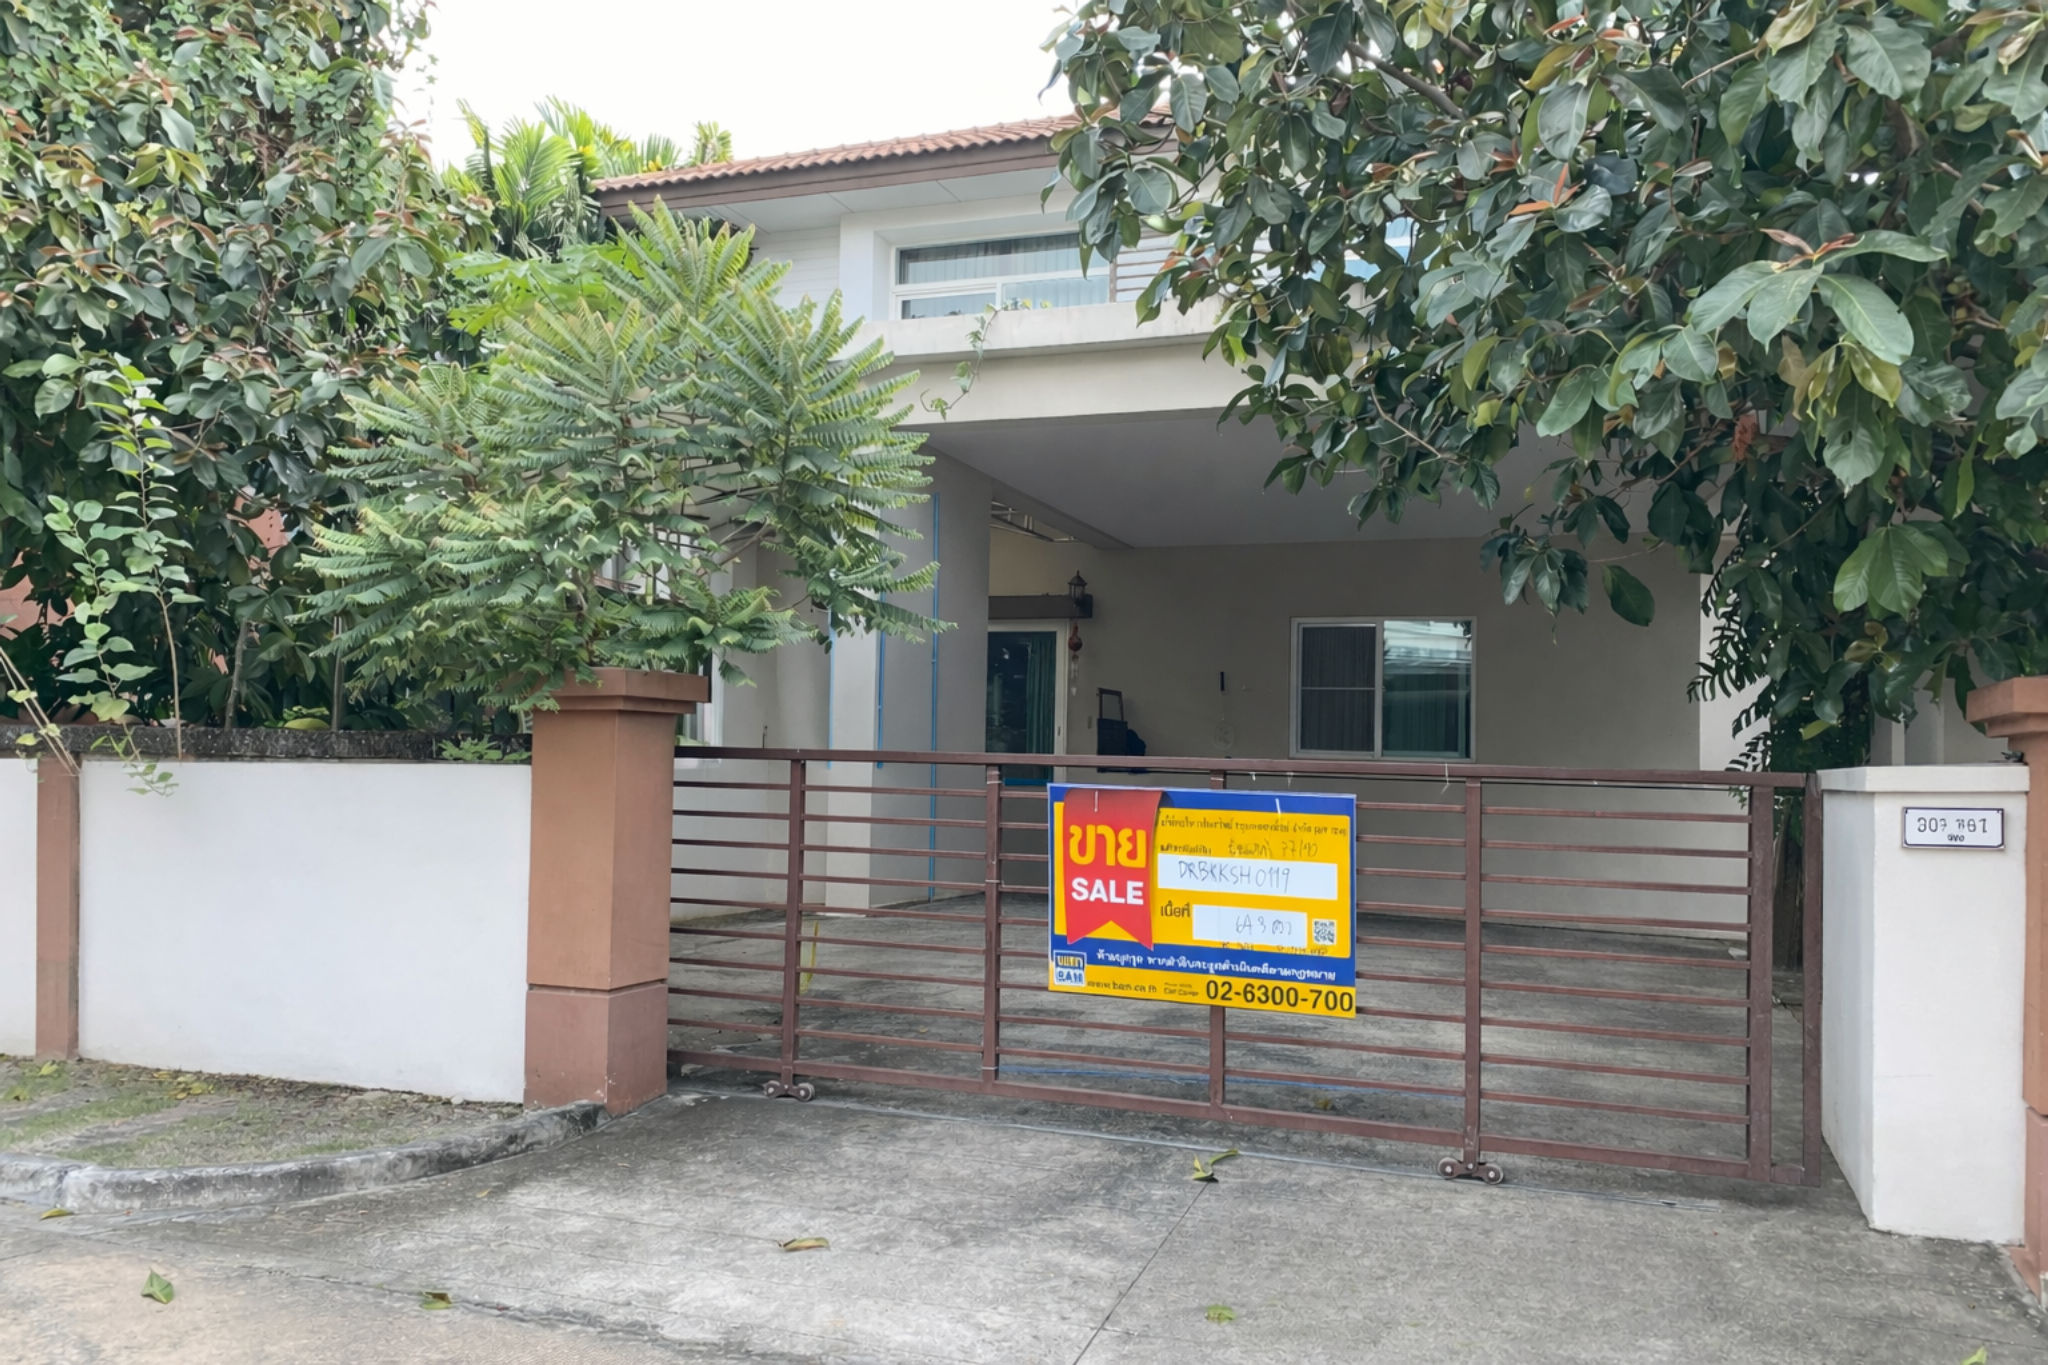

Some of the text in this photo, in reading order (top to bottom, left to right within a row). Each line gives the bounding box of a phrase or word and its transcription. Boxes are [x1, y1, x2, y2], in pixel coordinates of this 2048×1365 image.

[1069, 823, 1147, 869] ขาย
[1071, 876, 1144, 906] SALE
[1206, 979, 1353, 1012] 02-6300-700
